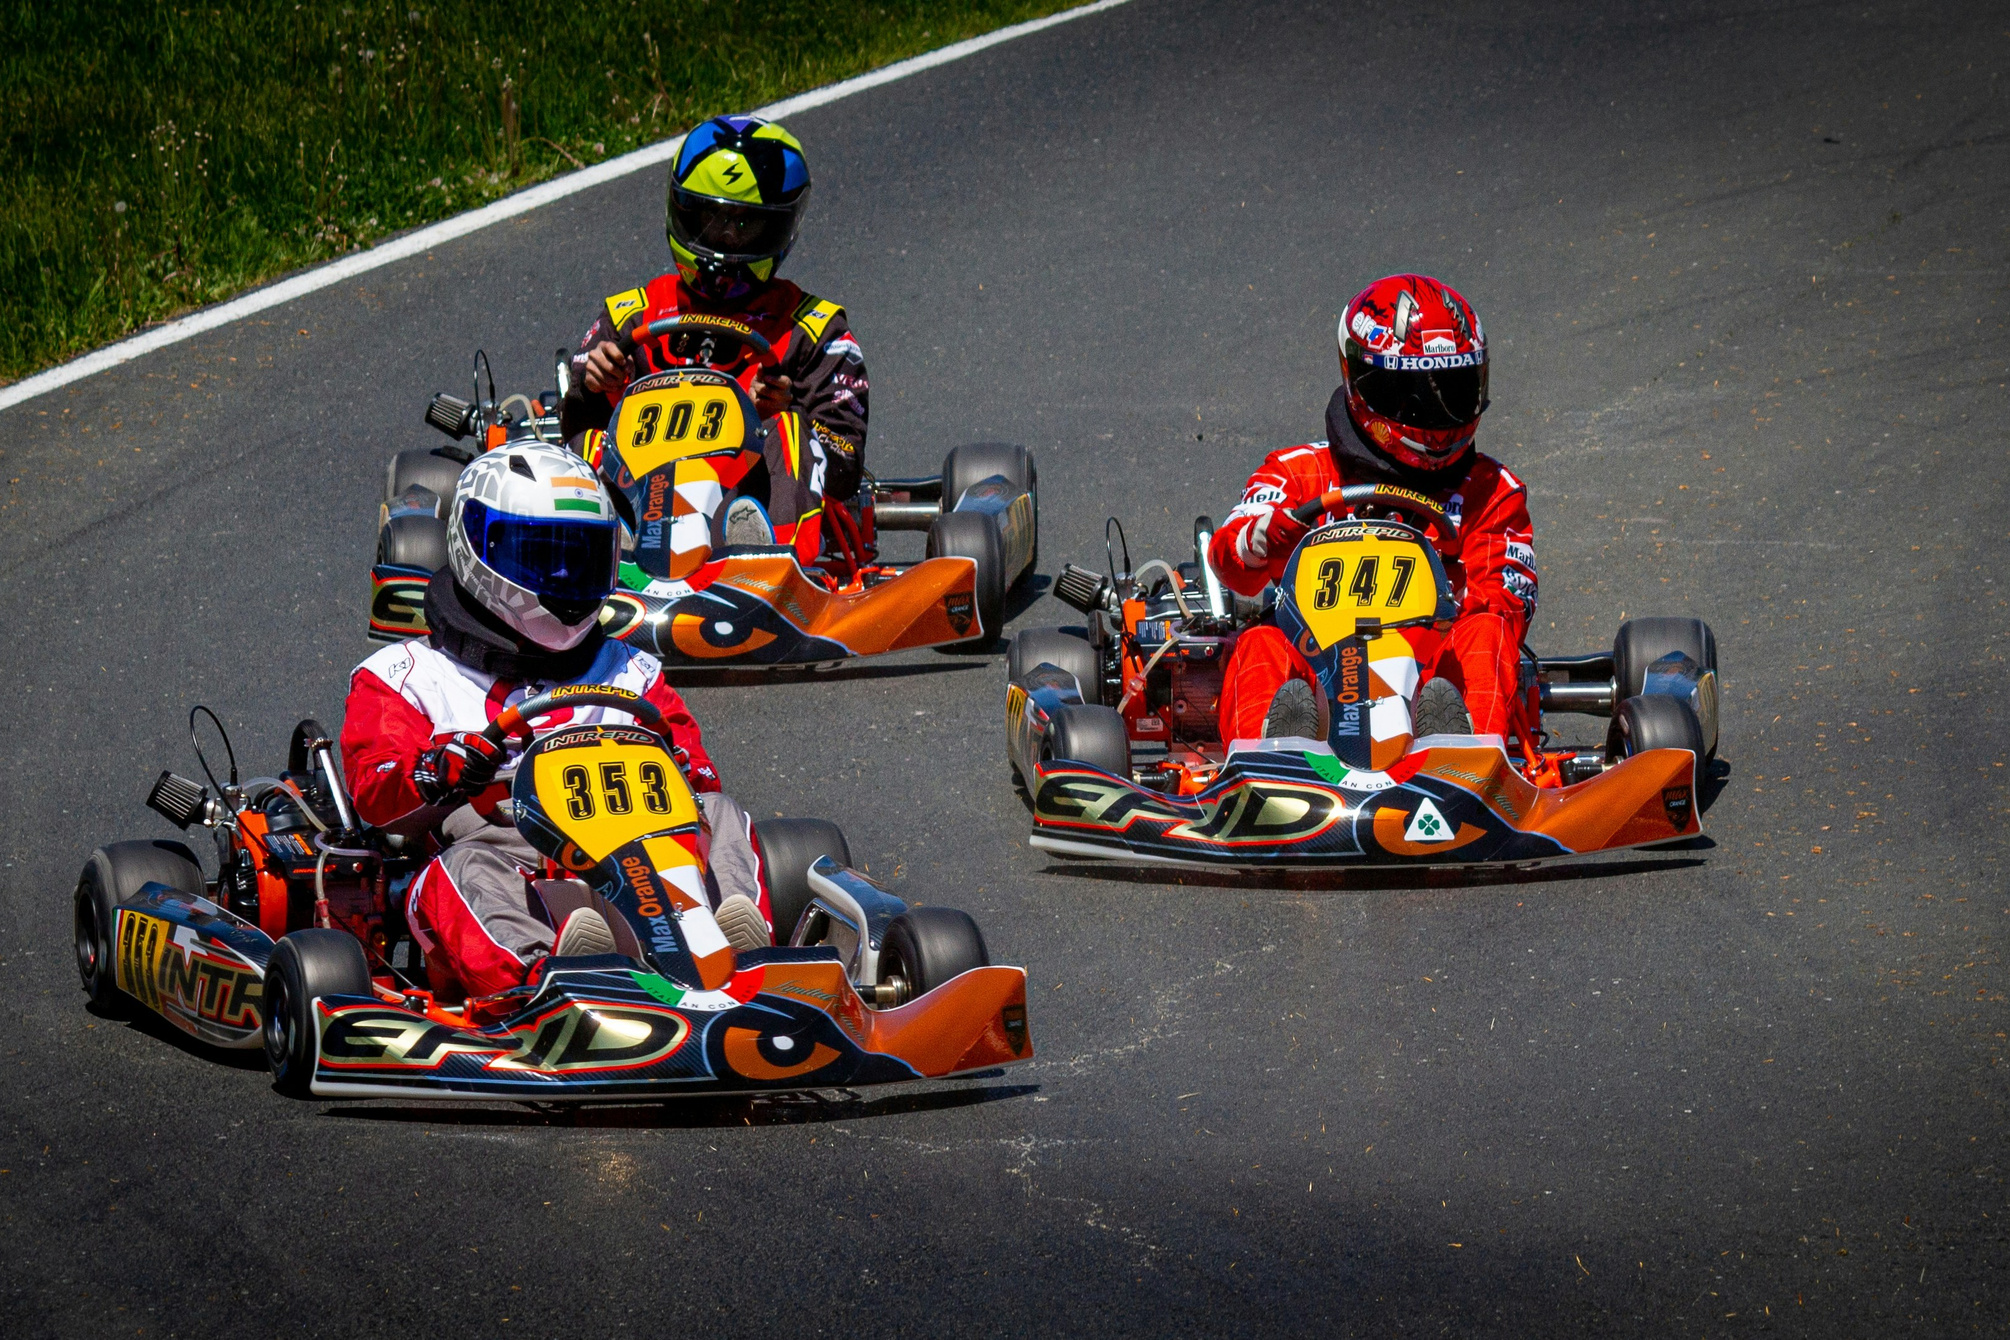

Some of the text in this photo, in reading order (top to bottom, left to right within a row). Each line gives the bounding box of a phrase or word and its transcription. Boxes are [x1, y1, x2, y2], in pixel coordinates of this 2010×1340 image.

[679, 313, 753, 334] INTREPID
[1424, 341, 1456, 353] Marlboro
[1400, 355, 1475, 370] HONDA
[632, 374, 727, 394] INTREPID
[632, 399, 728, 447] 303
[641, 473, 669, 549] MaxOrange
[1375, 483, 1445, 514] INTREPID
[1311, 526, 1415, 546] INTREPID
[1314, 556, 1416, 611] 347
[551, 684, 639, 700] INTREPID
[1337, 646, 1362, 736] MaxOrange
[543, 730, 656, 752] INTREPID
[563, 761, 672, 820] 353
[622, 856, 679, 953] MaxOrange
